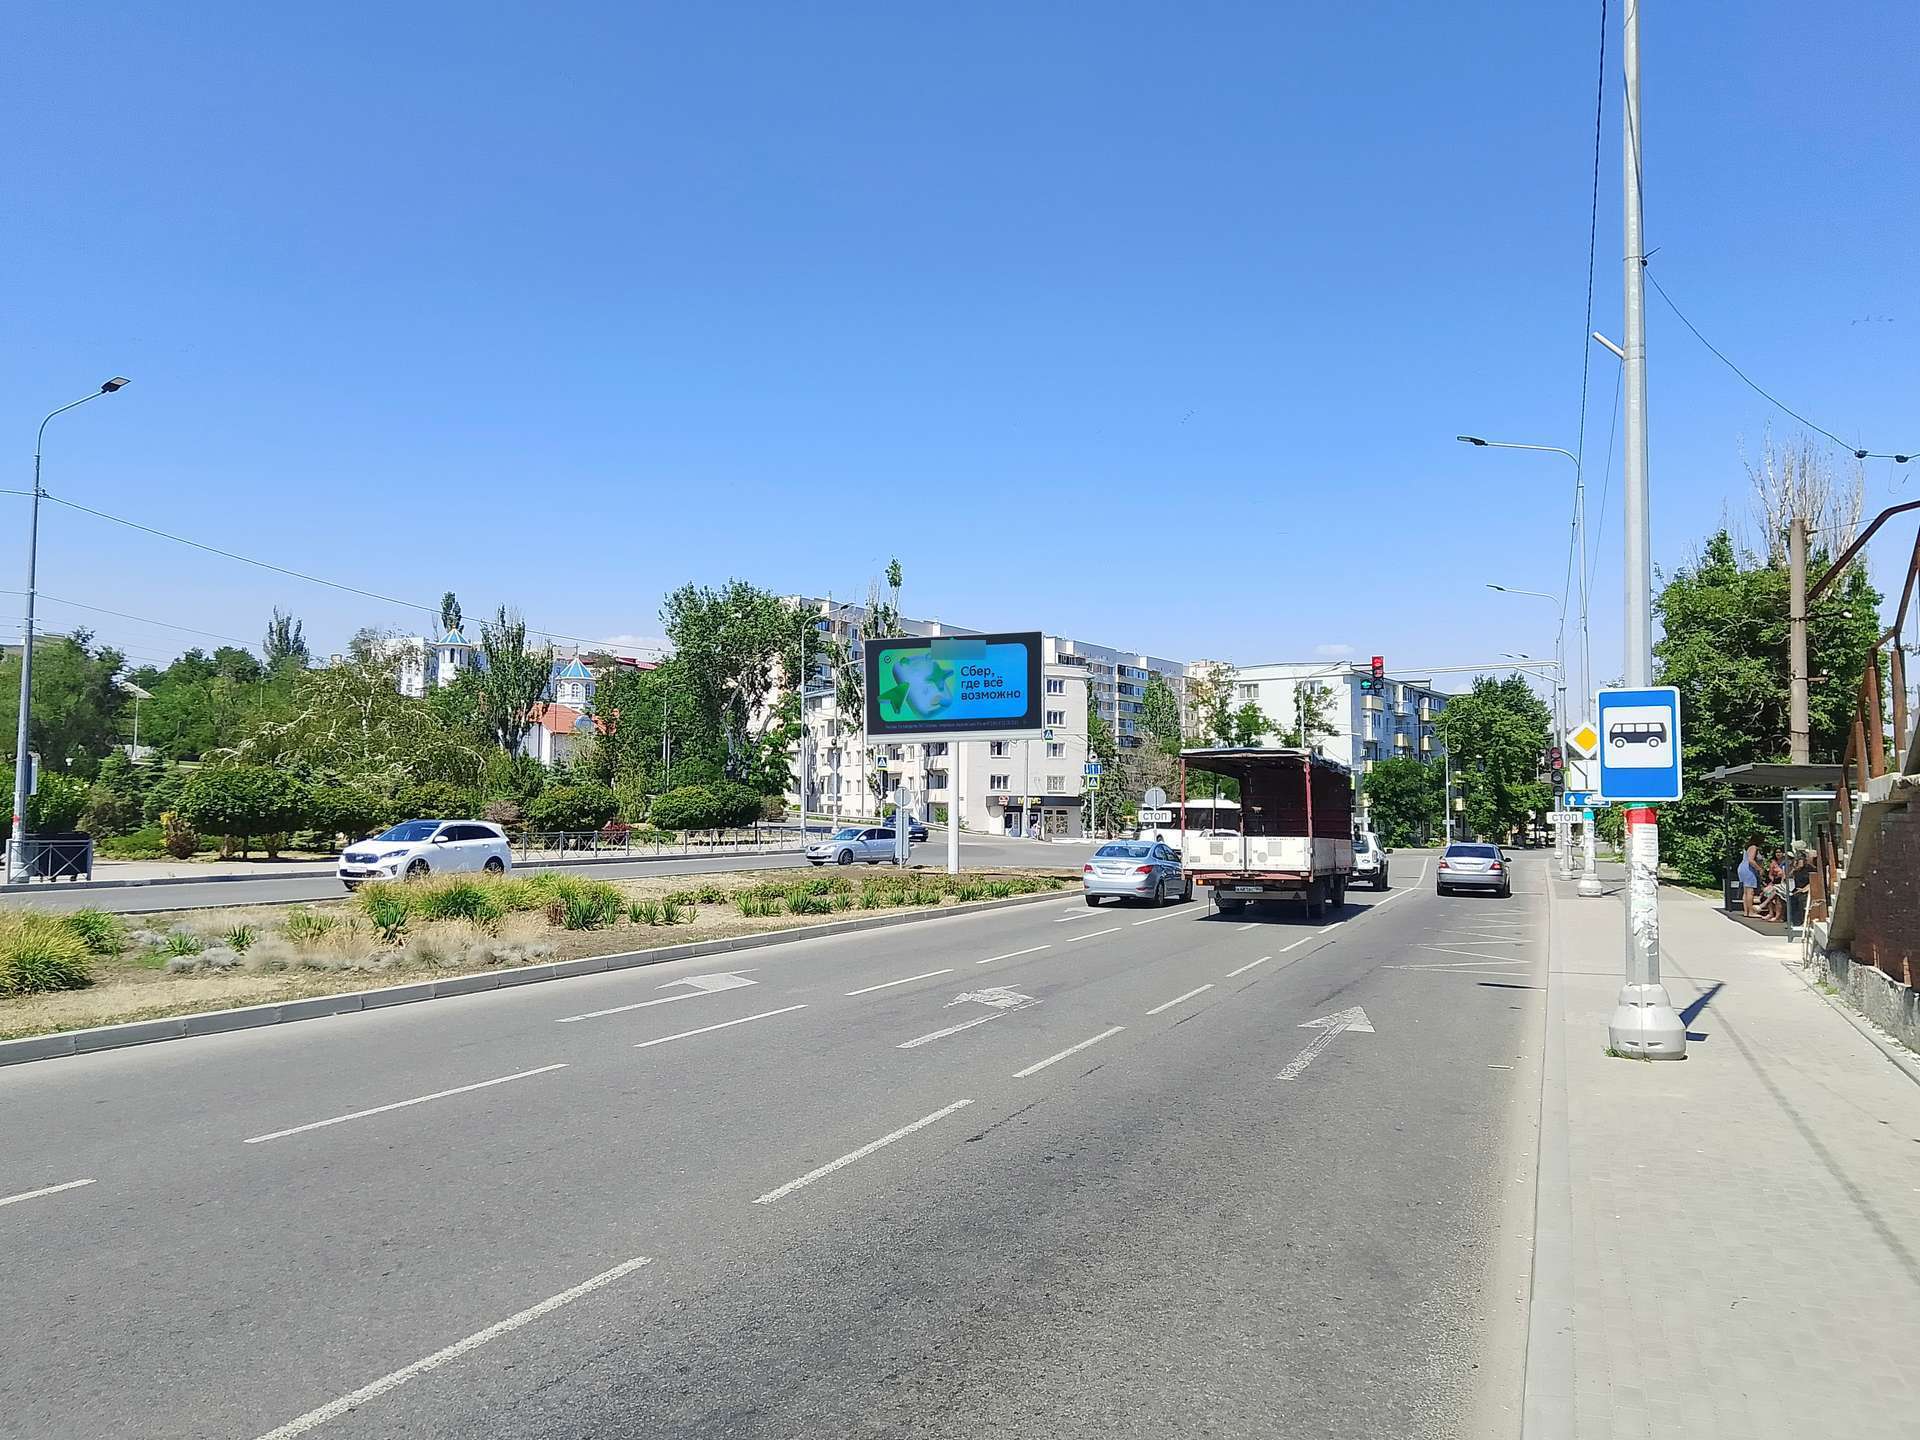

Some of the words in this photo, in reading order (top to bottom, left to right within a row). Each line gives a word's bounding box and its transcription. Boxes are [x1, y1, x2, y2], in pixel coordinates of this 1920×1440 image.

[961, 665, 995, 678] Сбер,
[961, 680, 980, 690] где
[983, 676, 1003, 688] всё
[961, 690, 1021, 701] возможно
[1142, 812, 1168, 821] СТОП
[1551, 813, 1578, 822] СТОП
